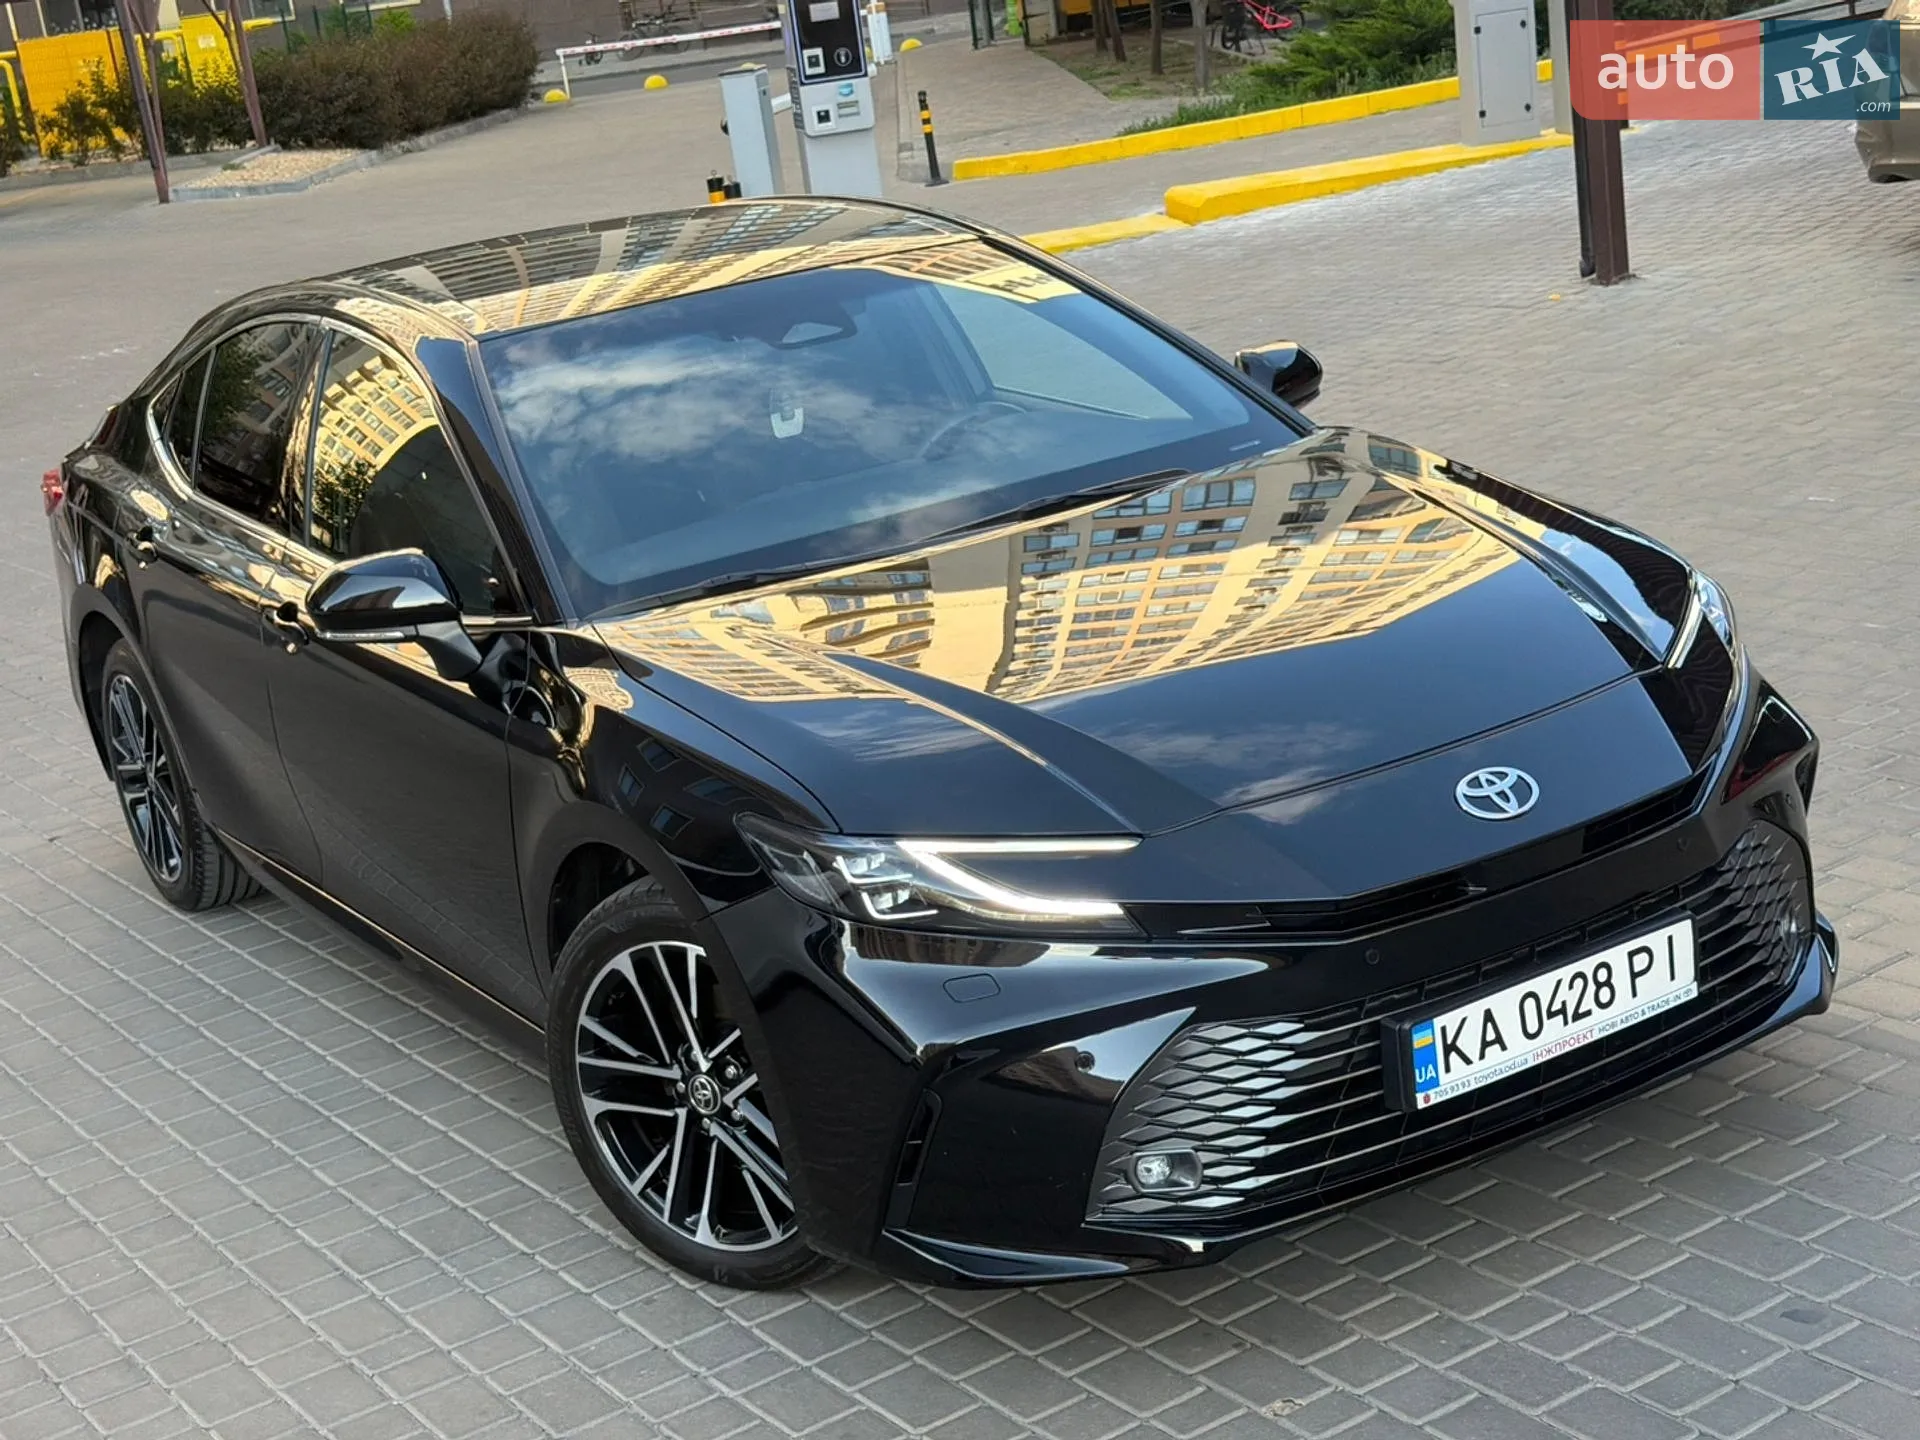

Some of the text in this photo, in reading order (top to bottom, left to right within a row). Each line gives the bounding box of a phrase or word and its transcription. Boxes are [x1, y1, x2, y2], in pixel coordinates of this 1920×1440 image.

[1439, 1007, 1508, 1074] KA
[1518, 961, 1616, 1040] 0428
[1533, 1028, 1594, 1062] ІНЖПРОЕКТ
[1416, 1063, 1437, 1083] UA
